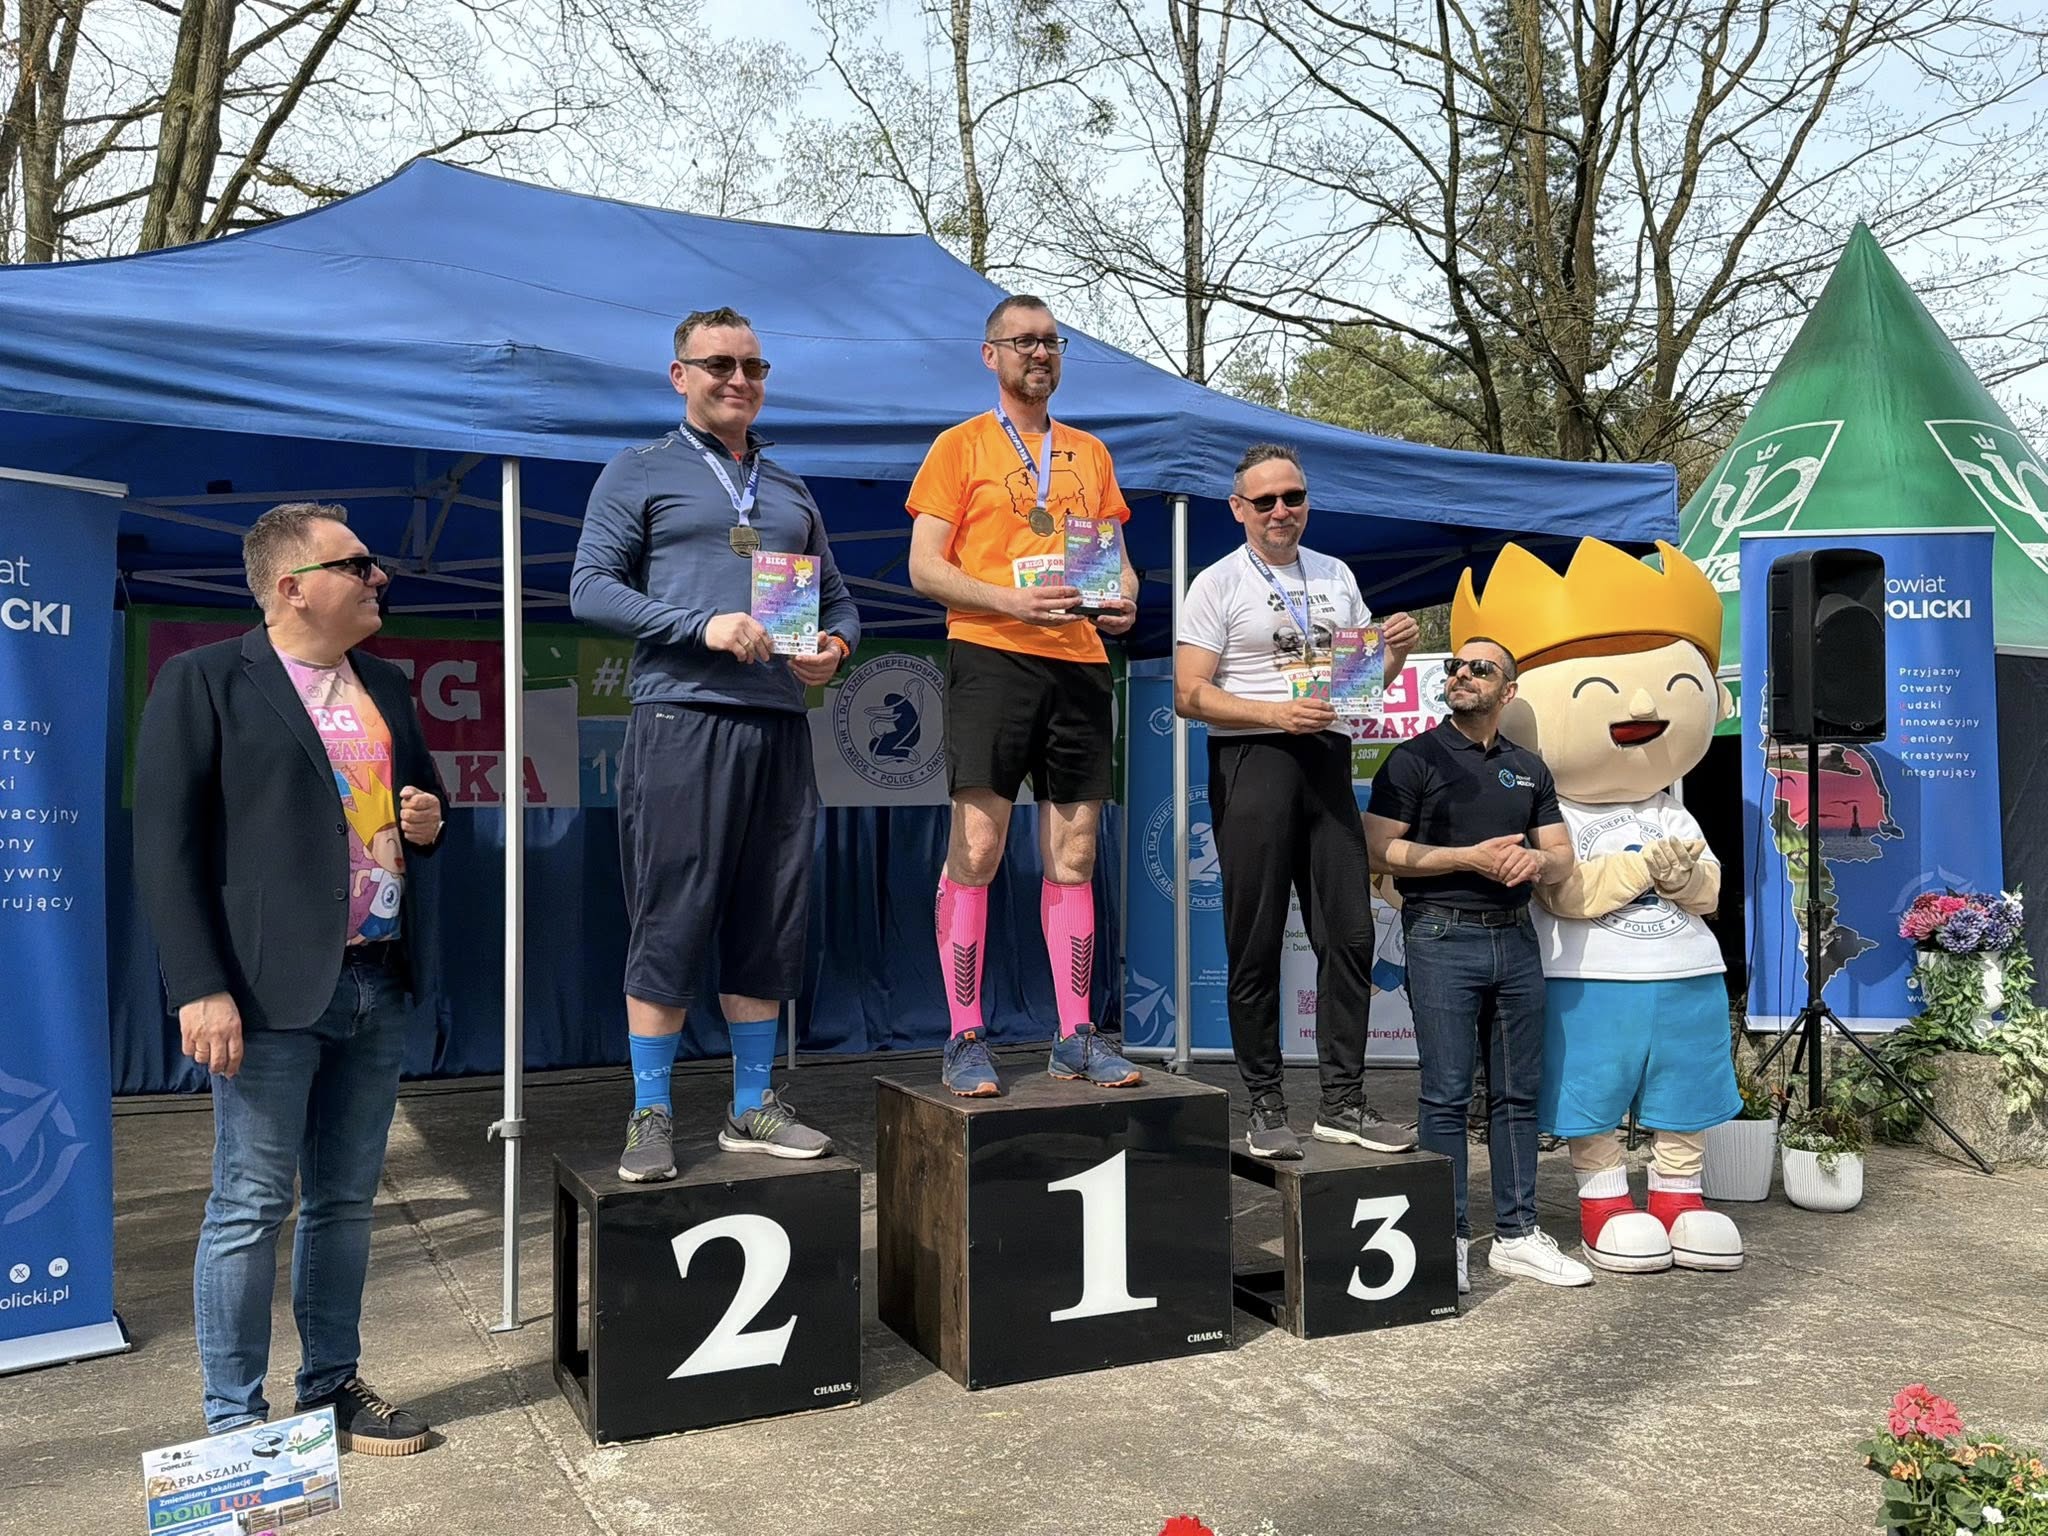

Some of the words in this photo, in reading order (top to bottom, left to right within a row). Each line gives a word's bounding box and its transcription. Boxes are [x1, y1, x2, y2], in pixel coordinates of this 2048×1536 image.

[1884, 573, 1946, 594] owiat
[1899, 666, 1961, 678] Przyjazny
[1900, 684, 1952, 695] Otwarty
[1900, 717, 1980, 729] Innowacyjny
[1901, 751, 1970, 762] Kreatywny
[880, 773, 915, 785] POLICE
[1901, 768, 1977, 779] Integrujący
[4, 867, 62, 882] ywny
[1623, 922, 1667, 933] POLICE
[1047, 1149, 1158, 1322] 1
[1346, 1194, 1417, 1300] 3
[667, 1213, 798, 1379] 2
[1187, 1330, 1223, 1344] CHABAS
[813, 1381, 852, 1397] CHABAS
[159, 1461, 252, 1492] ZAPRASZAMY
[154, 1501, 212, 1527] DOM
[219, 1492, 262, 1512] LUX
